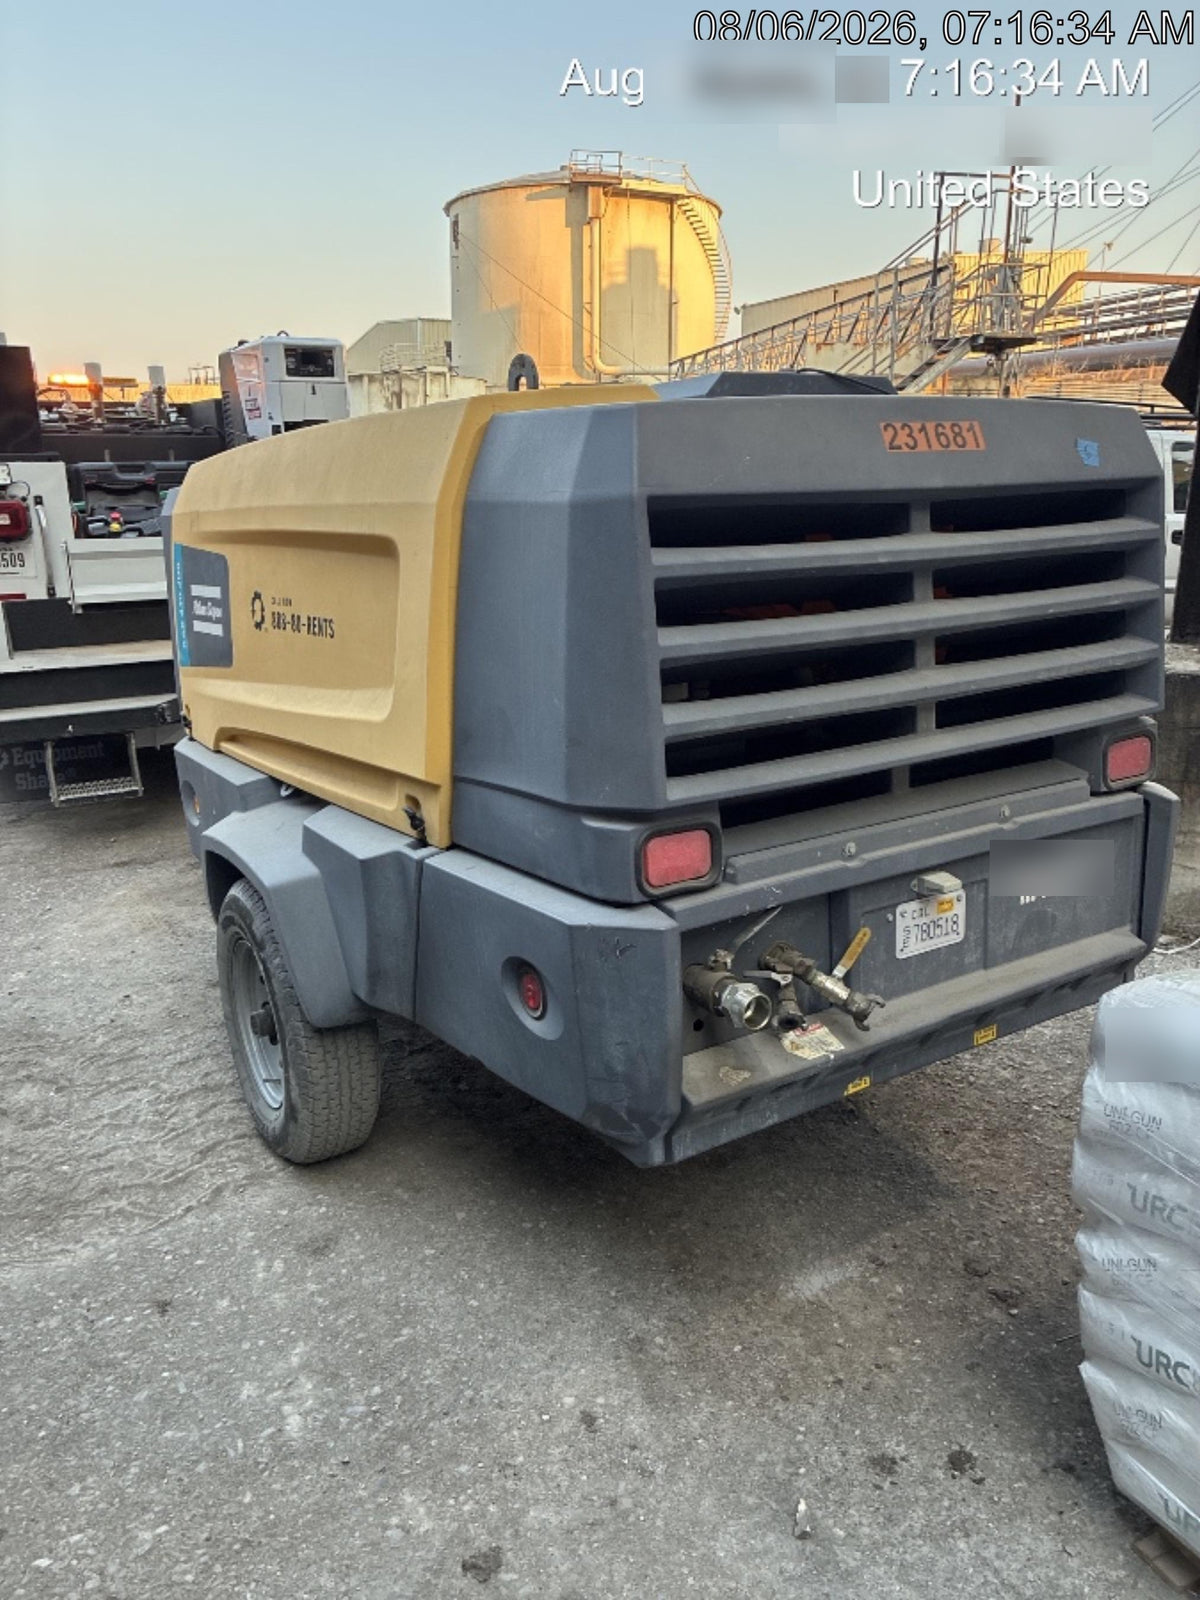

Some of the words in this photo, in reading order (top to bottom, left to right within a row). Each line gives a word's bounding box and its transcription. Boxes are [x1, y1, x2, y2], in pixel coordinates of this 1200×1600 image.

[883, 423, 981, 450] 231681
[0, 552, 26, 568] 509
[12, 742, 104, 768] Equpment
[15, 770, 65, 791] Shae
